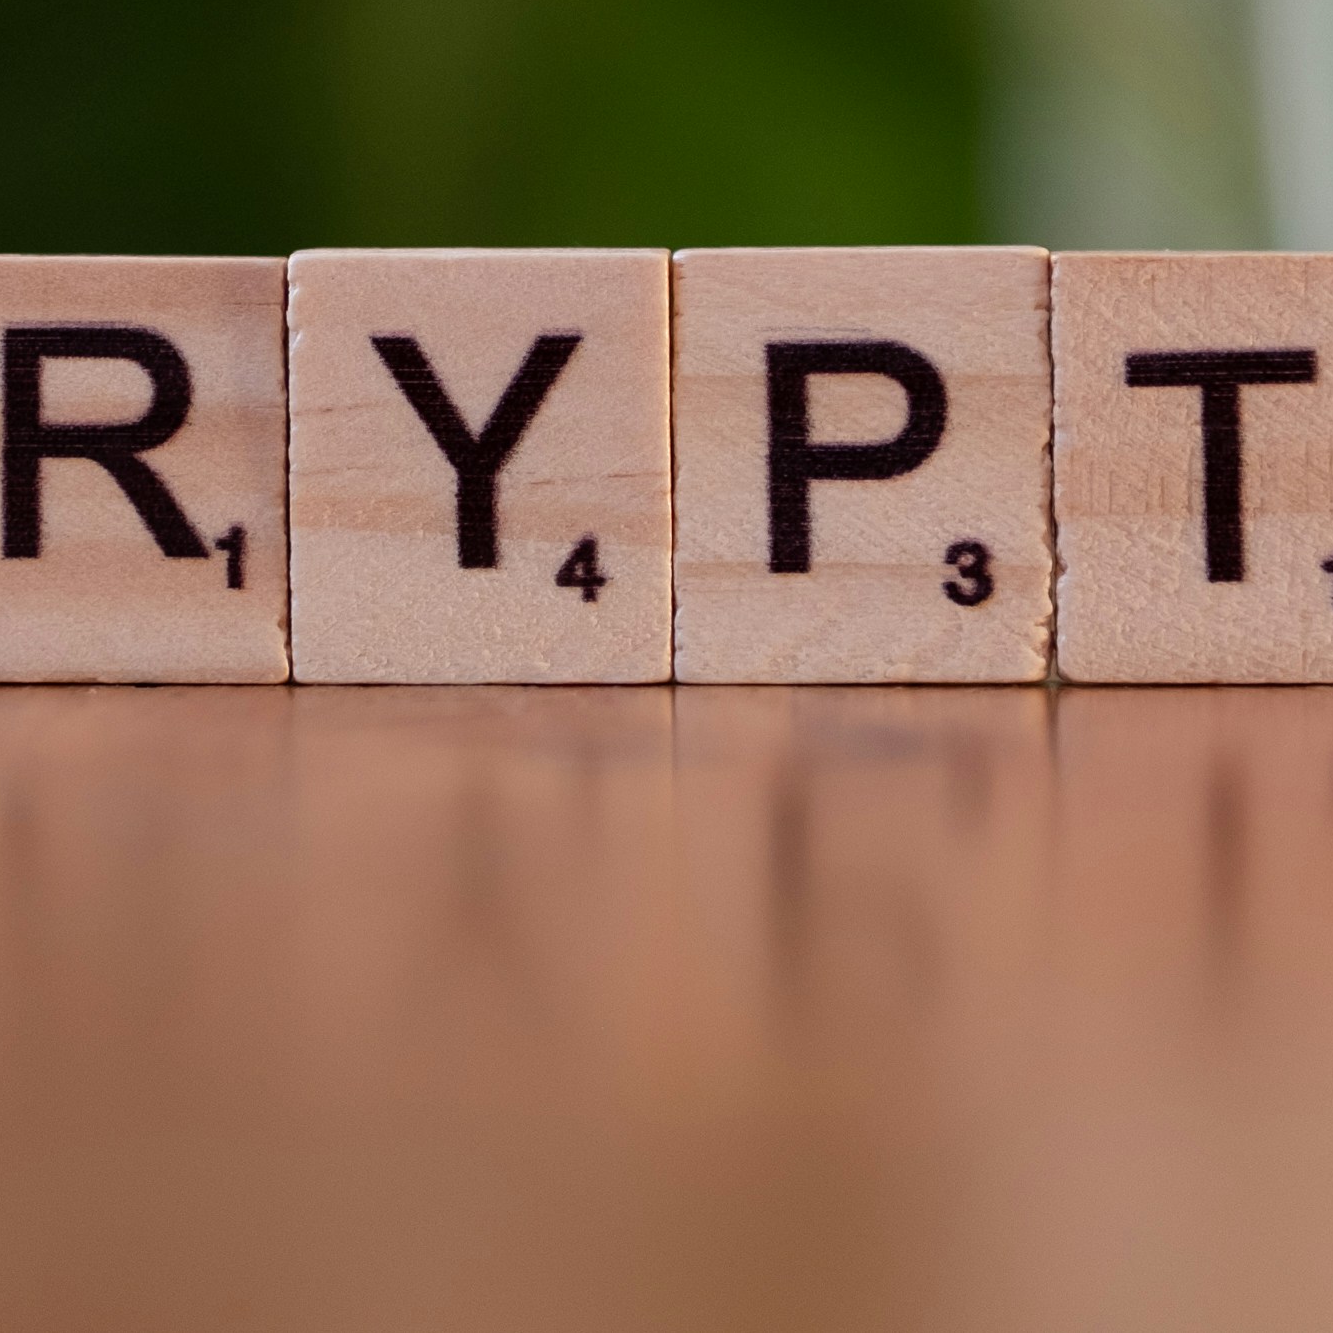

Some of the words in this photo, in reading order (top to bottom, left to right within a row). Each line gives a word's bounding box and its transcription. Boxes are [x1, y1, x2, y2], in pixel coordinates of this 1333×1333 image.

[212, 524, 249, 591] 1
[553, 535, 608, 604] 4
[942, 539, 996, 608] 3
